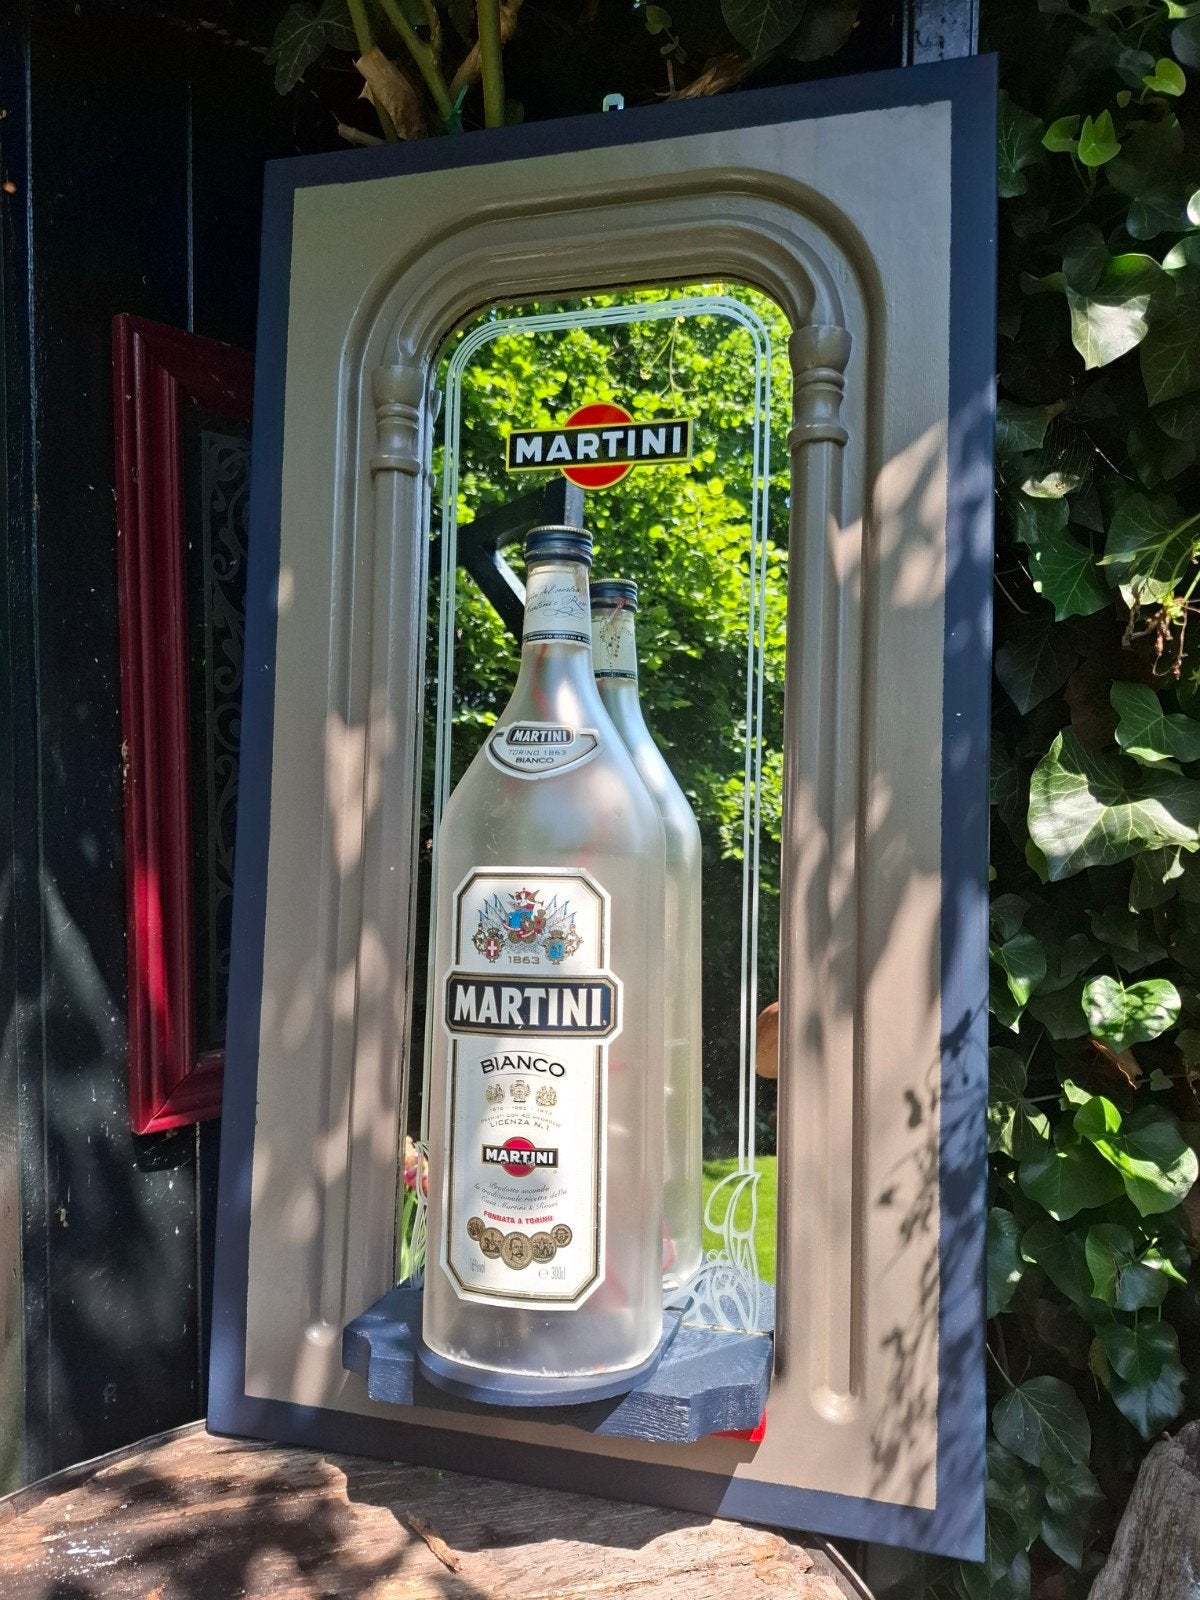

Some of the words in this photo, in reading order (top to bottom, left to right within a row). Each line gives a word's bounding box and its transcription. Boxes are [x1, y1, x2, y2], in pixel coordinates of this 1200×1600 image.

[515, 426, 682, 464] MARTINI
[512, 730, 567, 742] MARTINI
[507, 955, 540, 965] 1863
[453, 984, 604, 1027] MARTINI
[479, 1055, 566, 1078] BIANCO
[489, 1118, 530, 1128] LICENZA
[486, 1148, 554, 1165] MARTINI
[481, 1187, 523, 1202] tradizionale
[523, 1194, 548, 1203] ricetta
[497, 1200, 527, 1212] Martini
[483, 1210, 515, 1224] FONDATA
[517, 1217, 524, 1225] A
[525, 1214, 554, 1225] TORINO
